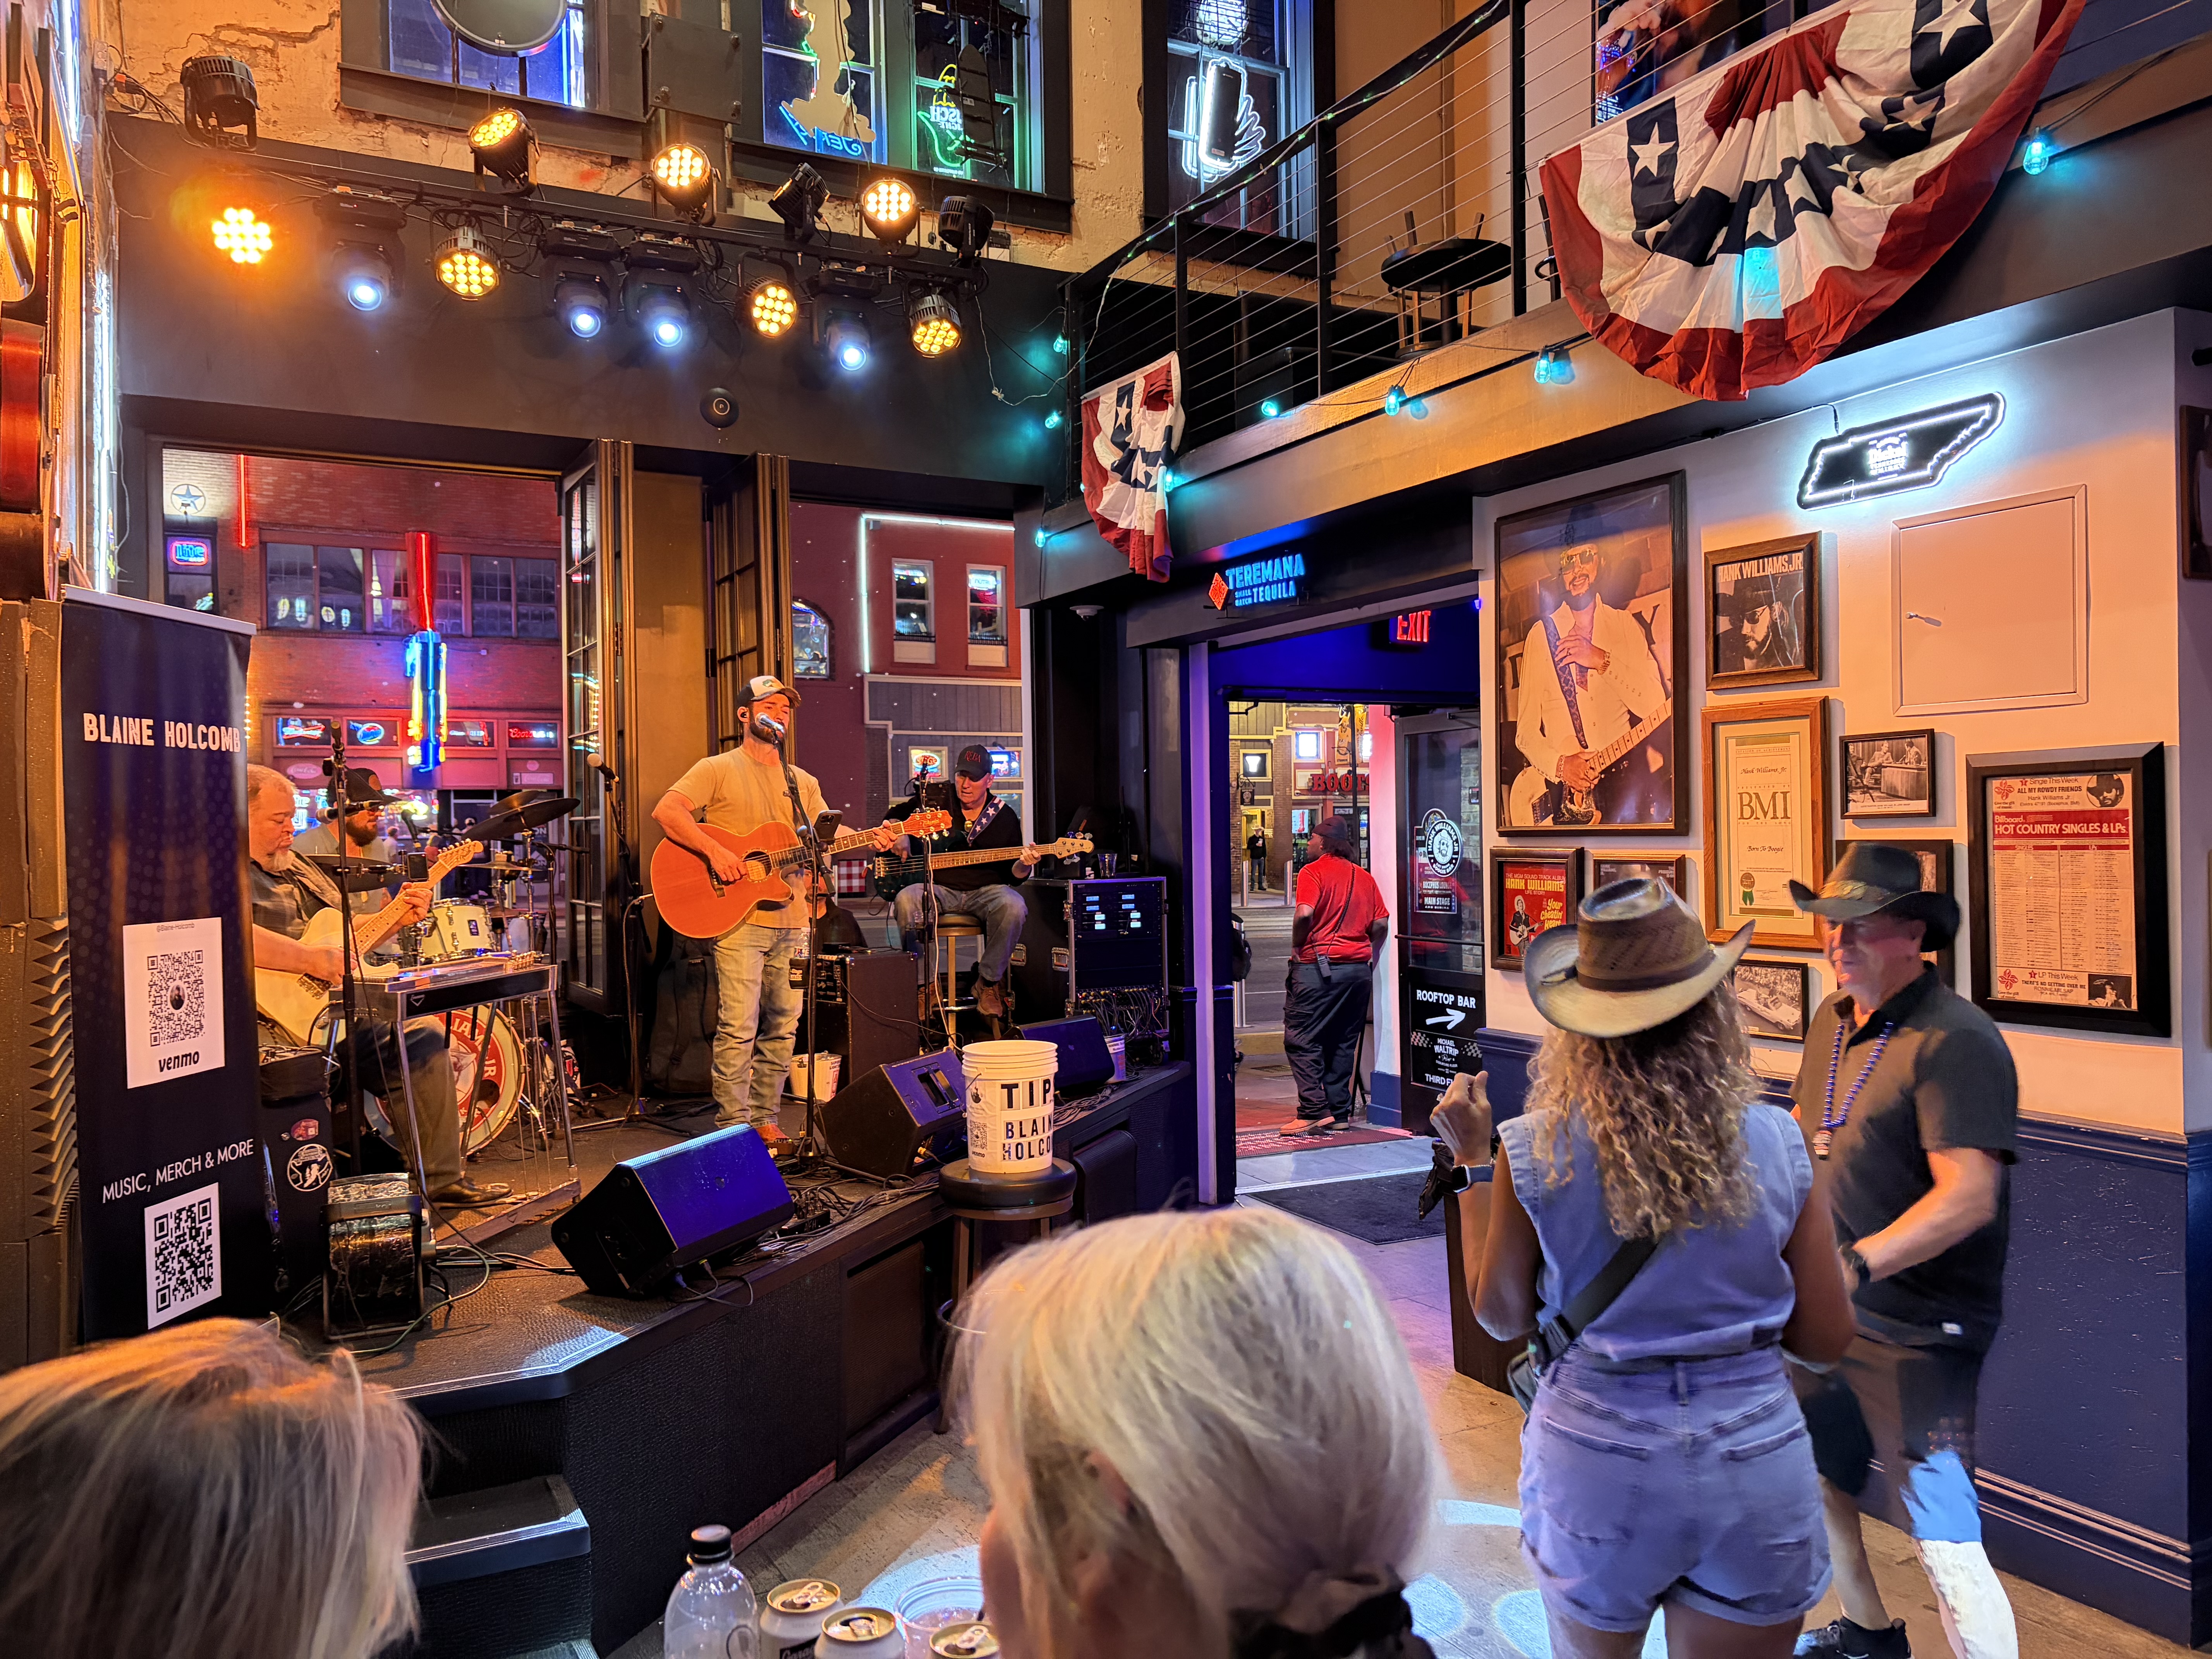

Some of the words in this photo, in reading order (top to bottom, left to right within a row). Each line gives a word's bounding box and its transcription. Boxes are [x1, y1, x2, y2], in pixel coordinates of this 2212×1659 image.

[1225, 553, 1305, 589] TEREMANA
[1719, 563, 1741, 582] HANK
[1235, 589, 1251, 598] SMALL
[1252, 580, 1297, 603] TEQUILA
[1397, 610, 1431, 642] EXIT
[83, 713, 154, 746] BLAINE
[165, 720, 241, 753] HOLCOMB
[1738, 791, 1791, 820] BMI
[1434, 823, 1457, 841] WILLIAMS
[1995, 824, 2015, 835] HOT
[2016, 824, 2061, 835] COUNTRY
[2062, 823, 2100, 834] SINGLES
[2102, 823, 2109, 833] &
[1505, 878, 1525, 890] HANK
[1527, 879, 1565, 892] WILLIAMS
[1424, 897, 1436, 905] MAIN
[1436, 897, 1450, 905] STAGE
[1547, 898, 1563, 910] Your
[1416, 989, 1455, 1005] ROOFTOP
[1457, 995, 1476, 1009] BAR
[1434, 1045, 1459, 1057] WALTRIP
[1437, 1037, 1455, 1047] MICHAEL
[158, 1050, 200, 1073] venmo
[1424, 1073, 1446, 1085] THIRD
[1001, 1078, 1051, 1109] TIP
[972, 1150, 985, 1159] venmo
[102, 1173, 152, 1204] MUSIC,
[155, 1158, 203, 1186] MERCH
[204, 1151, 214, 1169] &
[217, 1138, 254, 1166] MORE
